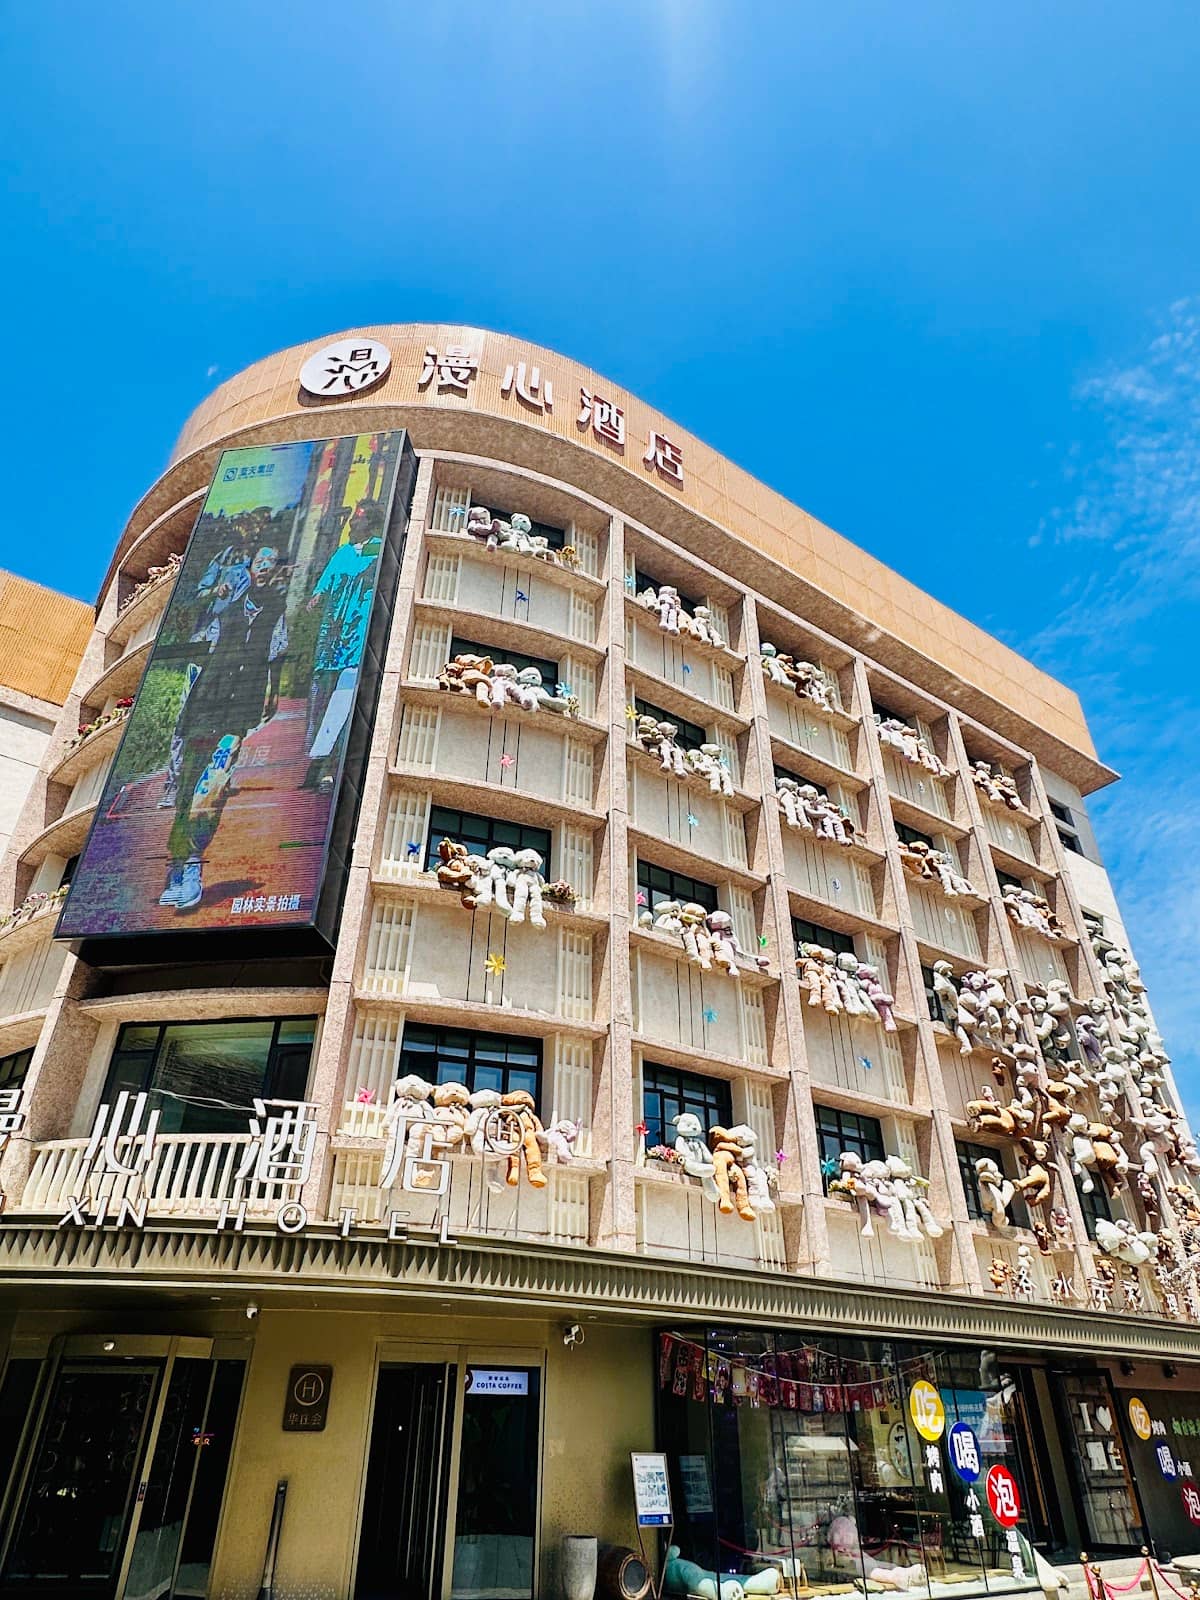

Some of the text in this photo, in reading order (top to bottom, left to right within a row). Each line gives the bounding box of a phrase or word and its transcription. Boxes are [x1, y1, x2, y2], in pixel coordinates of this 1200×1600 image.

[417, 344, 684, 482] 漫心酒店
[231, 894, 301, 914] 园林实景拍摄
[58, 1195, 458, 1245] XIN HOTEL
[476, 1382, 522, 1390] COSTA COFFEE
[914, 1386, 944, 1433] 吃
[1131, 1405, 1151, 1434] 吃
[952, 1431, 980, 1474] 喝
[1156, 1445, 1176, 1476] 喝
[990, 1473, 1019, 1518] 泡
